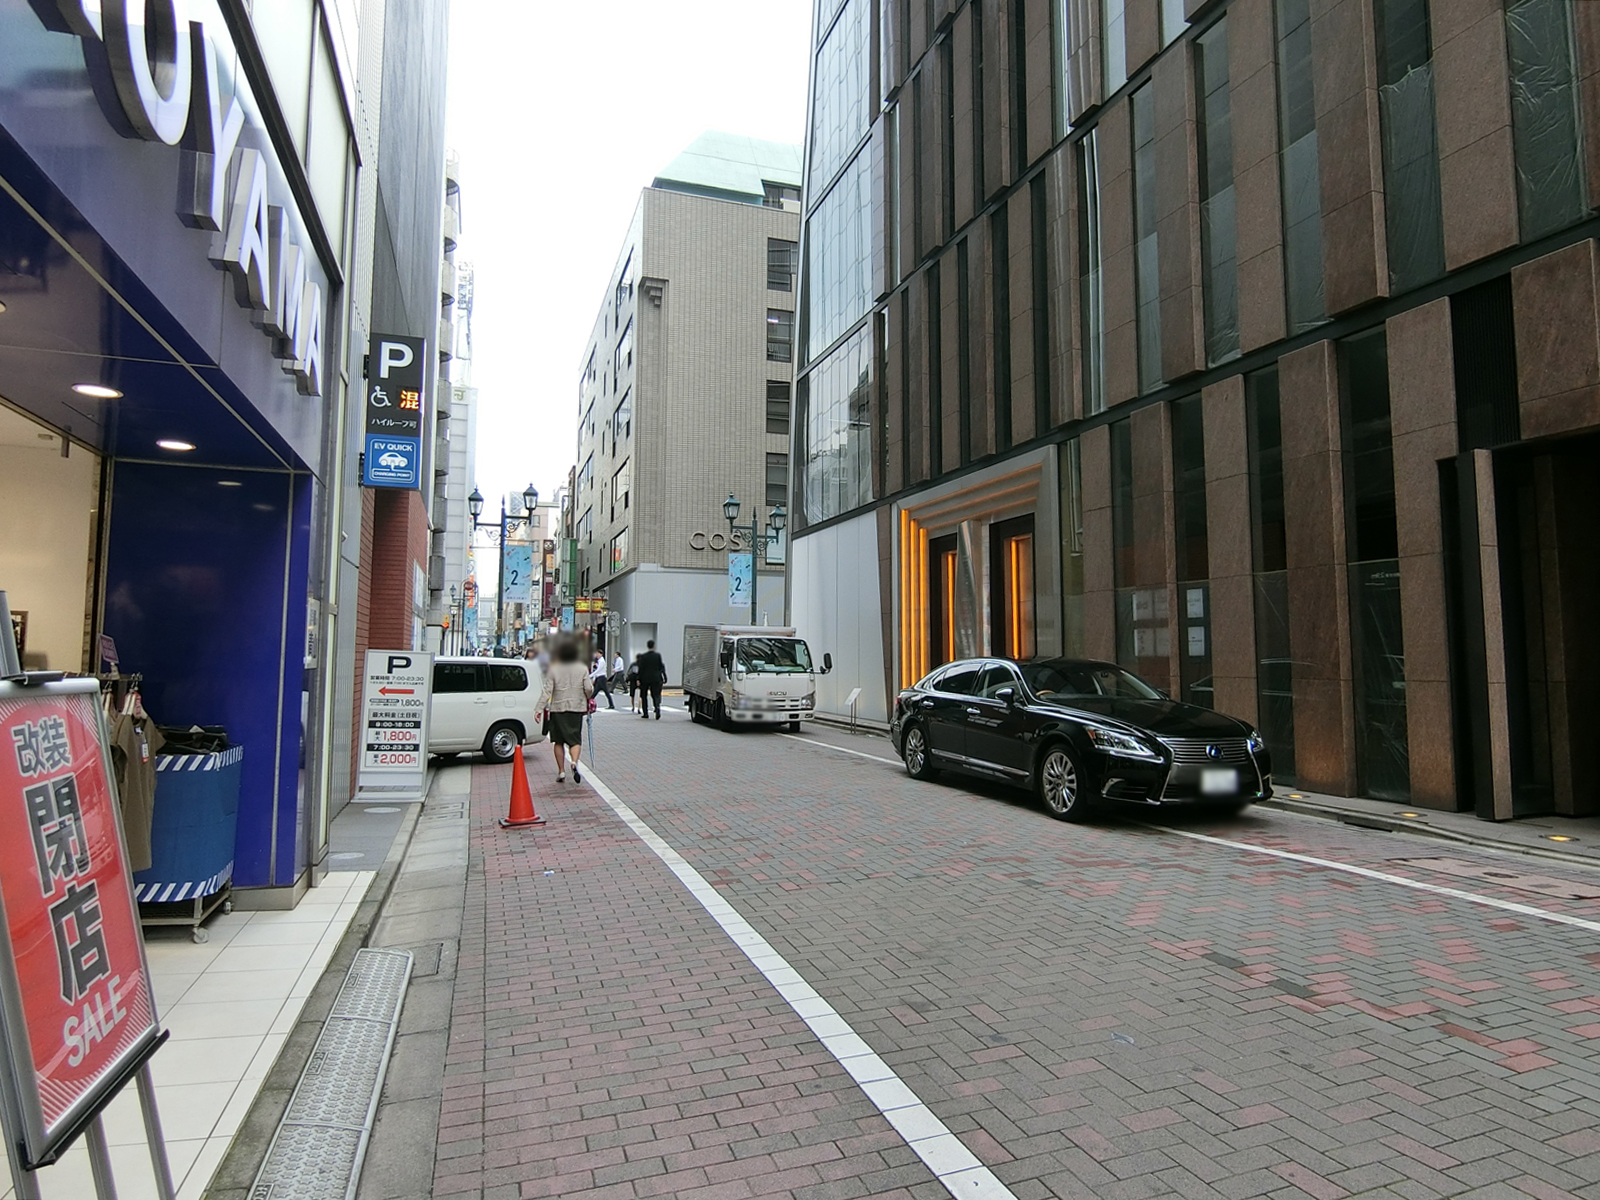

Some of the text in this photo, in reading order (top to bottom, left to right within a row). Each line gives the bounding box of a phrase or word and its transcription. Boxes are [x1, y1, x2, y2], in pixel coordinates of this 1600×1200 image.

[82, 0, 322, 397] OYAMA
[380, 341, 414, 379] P
[400, 389, 420, 410] 混
[374, 442, 413, 452] EV QUICK
[689, 531, 742, 551] COS
[510, 569, 519, 586] 2
[735, 576, 742, 592] 2
[387, 655, 412, 674] P
[11, 715, 73, 779] 改装
[23, 771, 112, 1006] 閉店
[63, 974, 129, 1070] SALE
